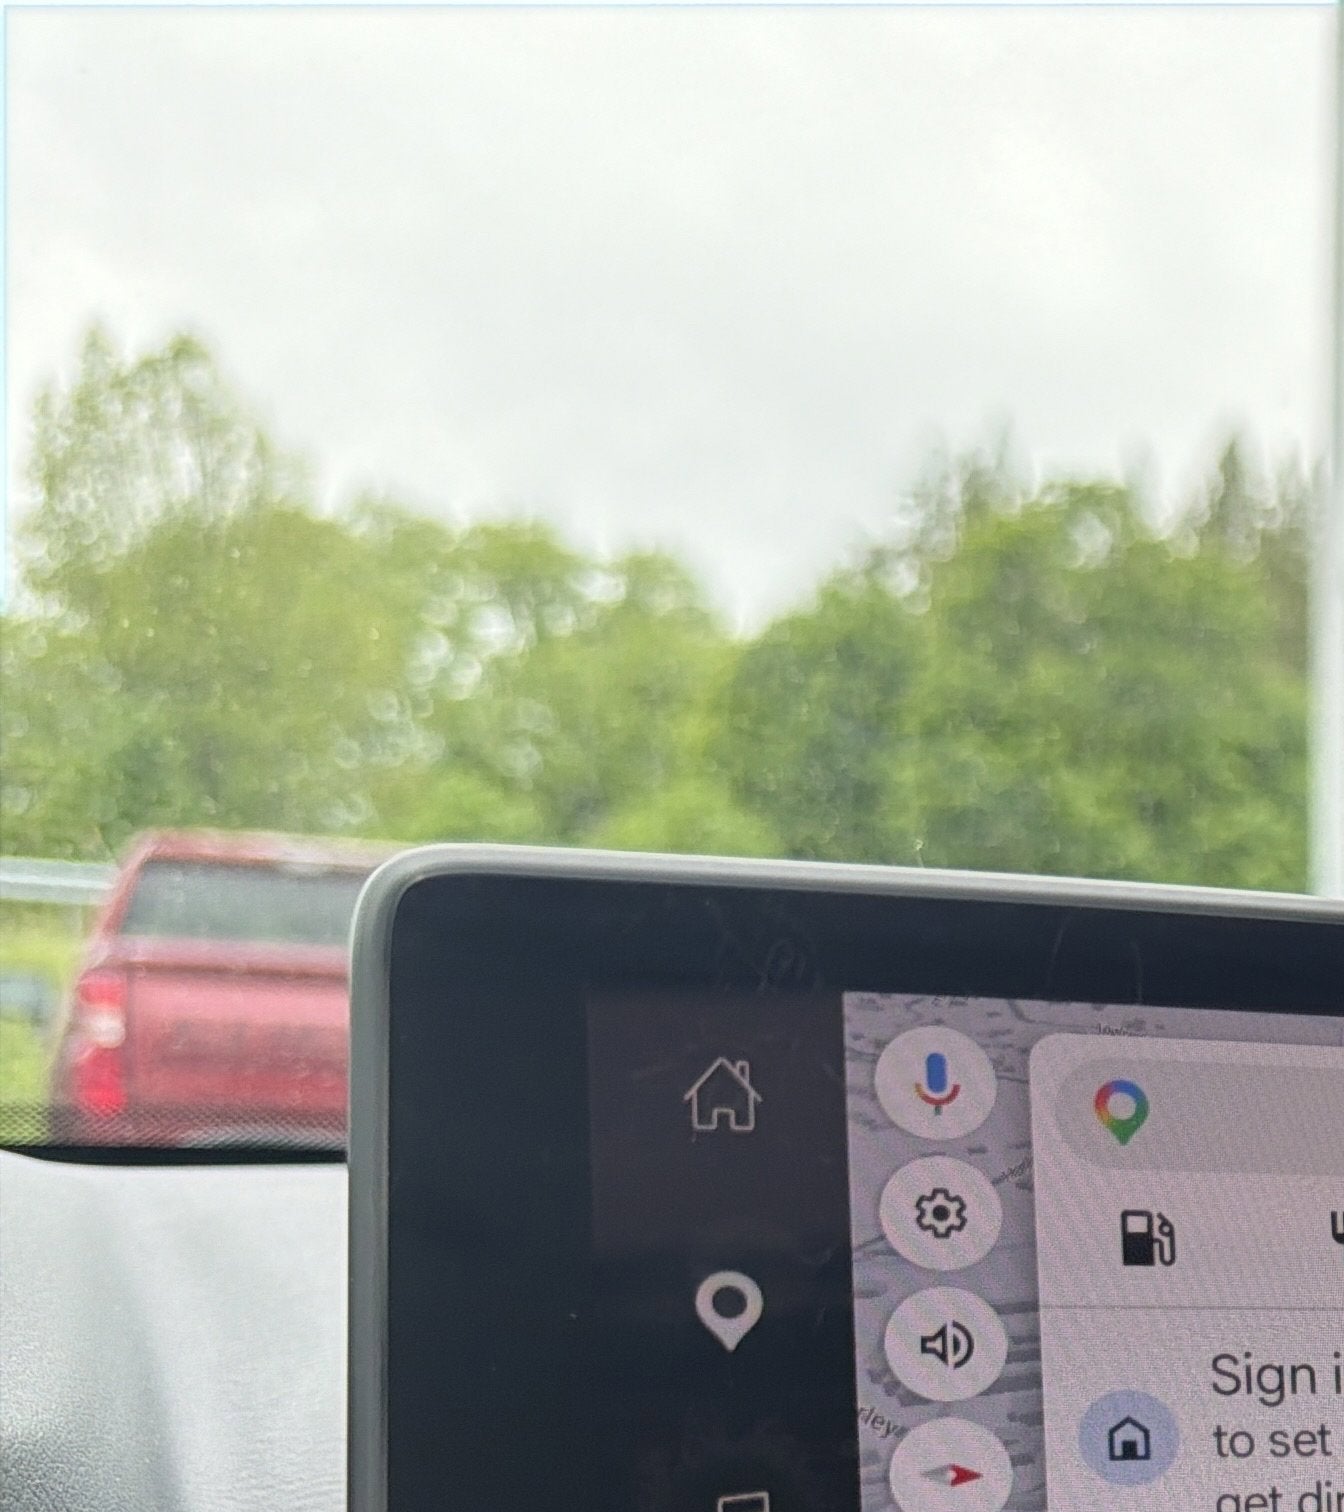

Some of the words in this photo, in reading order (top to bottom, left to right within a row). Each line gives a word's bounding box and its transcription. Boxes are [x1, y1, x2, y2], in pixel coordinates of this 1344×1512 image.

[1211, 1351, 1317, 1407] Sign
[1212, 1424, 1255, 1458] to
[1268, 1423, 1333, 1458] set
